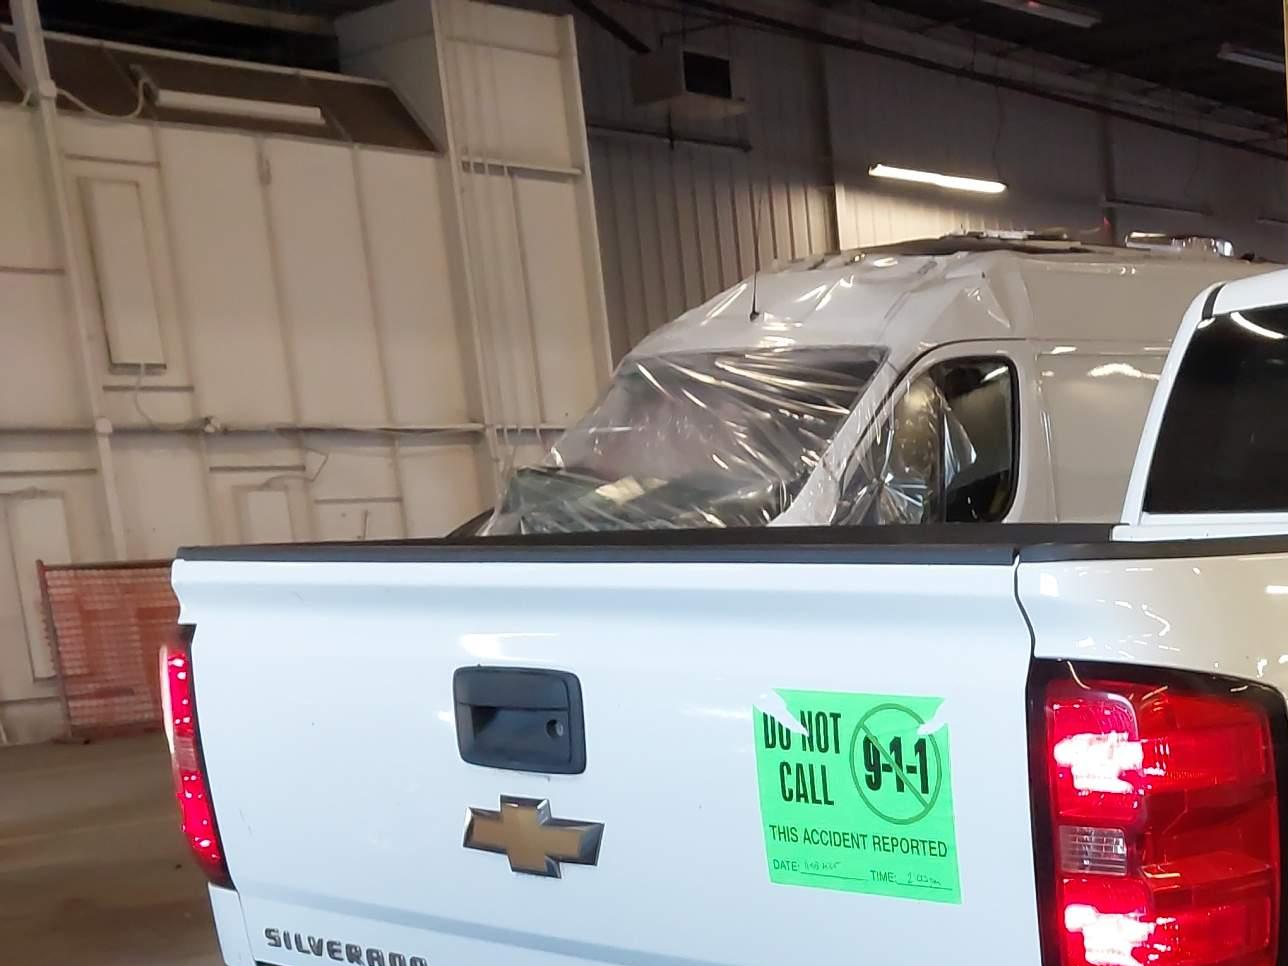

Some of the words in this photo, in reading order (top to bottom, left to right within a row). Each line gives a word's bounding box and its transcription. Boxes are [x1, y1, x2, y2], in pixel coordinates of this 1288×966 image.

[799, 710, 842, 754] NOT
[779, 761, 835, 806] CALL
[862, 735, 929, 795] 9-1-1
[768, 824, 799, 843] THIS
[803, 829, 868, 850] ACCIDENT
[872, 835, 949, 858] REPORTED
[772, 858, 800, 872] DATE:
[869, 869, 898, 884] TIME:
